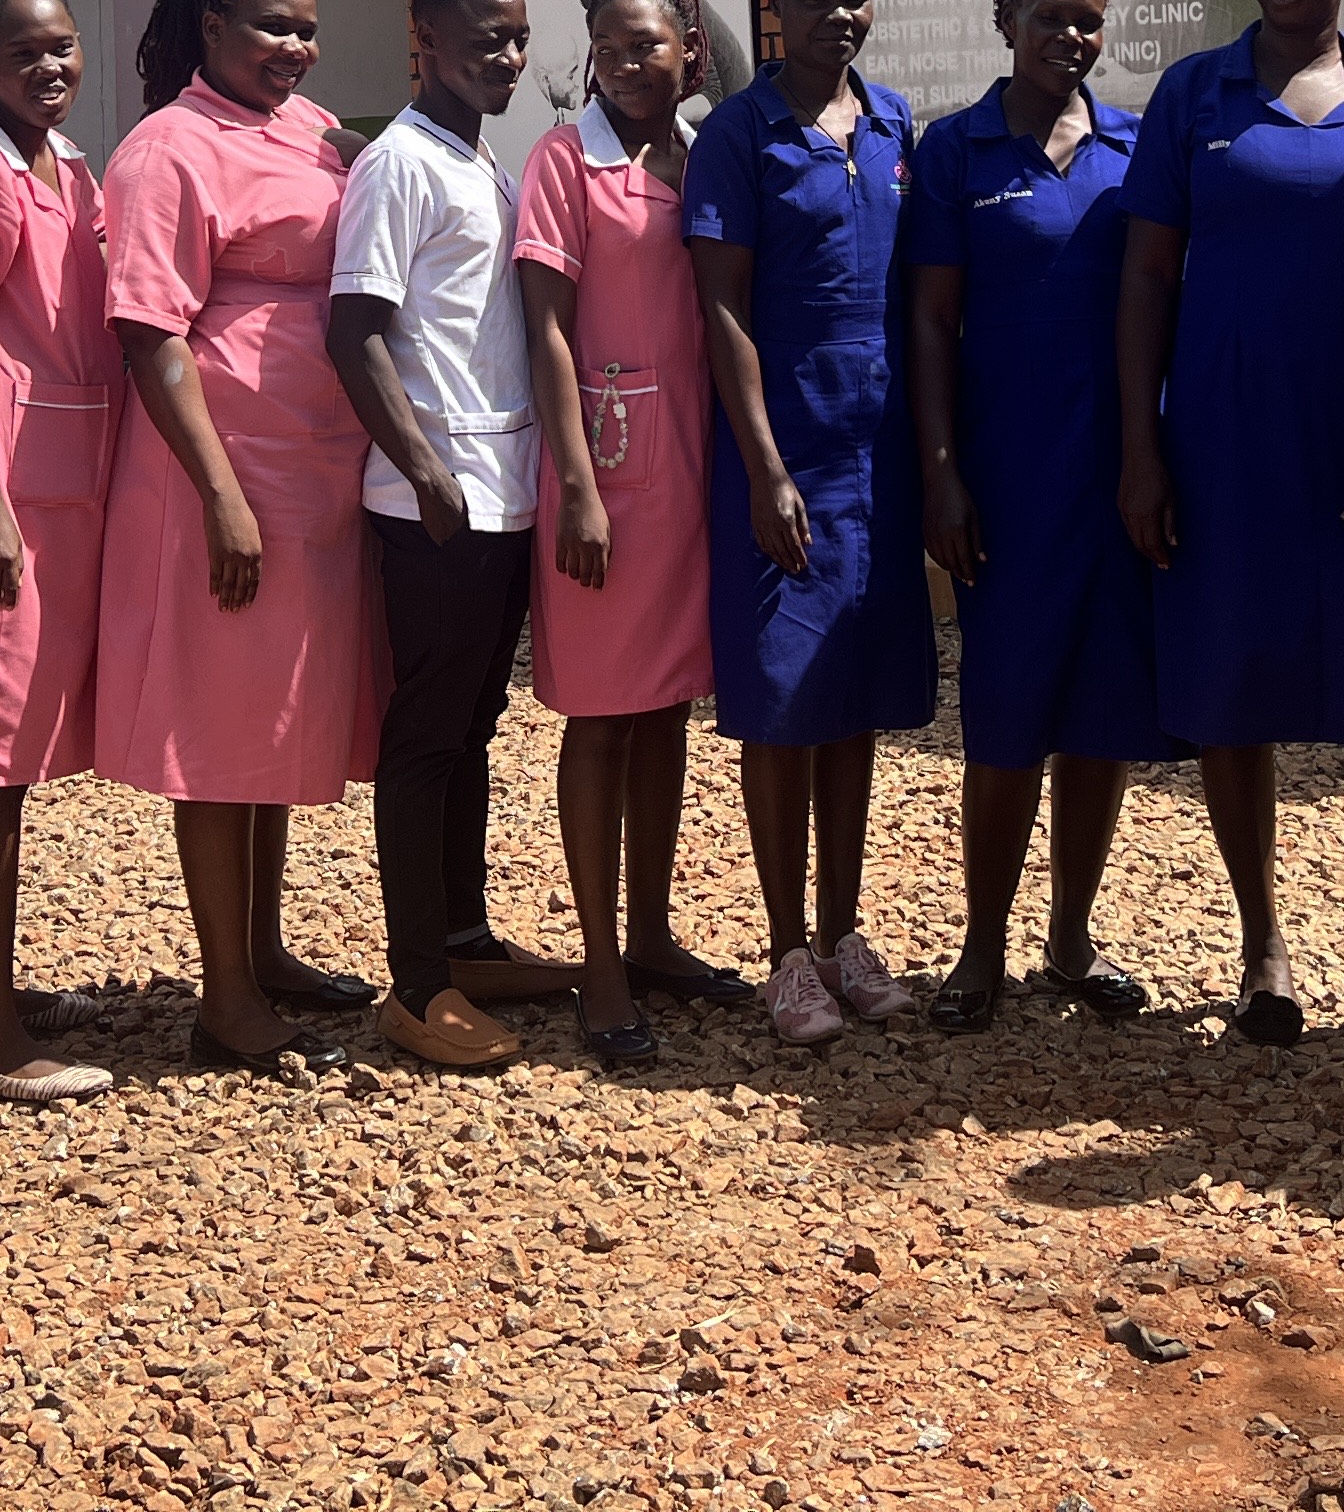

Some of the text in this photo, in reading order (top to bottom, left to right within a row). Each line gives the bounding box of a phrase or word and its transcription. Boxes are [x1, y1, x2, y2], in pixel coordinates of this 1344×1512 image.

[1135, 1, 1204, 26] CLINIC
[865, 54, 906, 76] EAR,
[909, 51, 960, 74] NOSE
[1103, 39, 1161, 65] LINIC)
